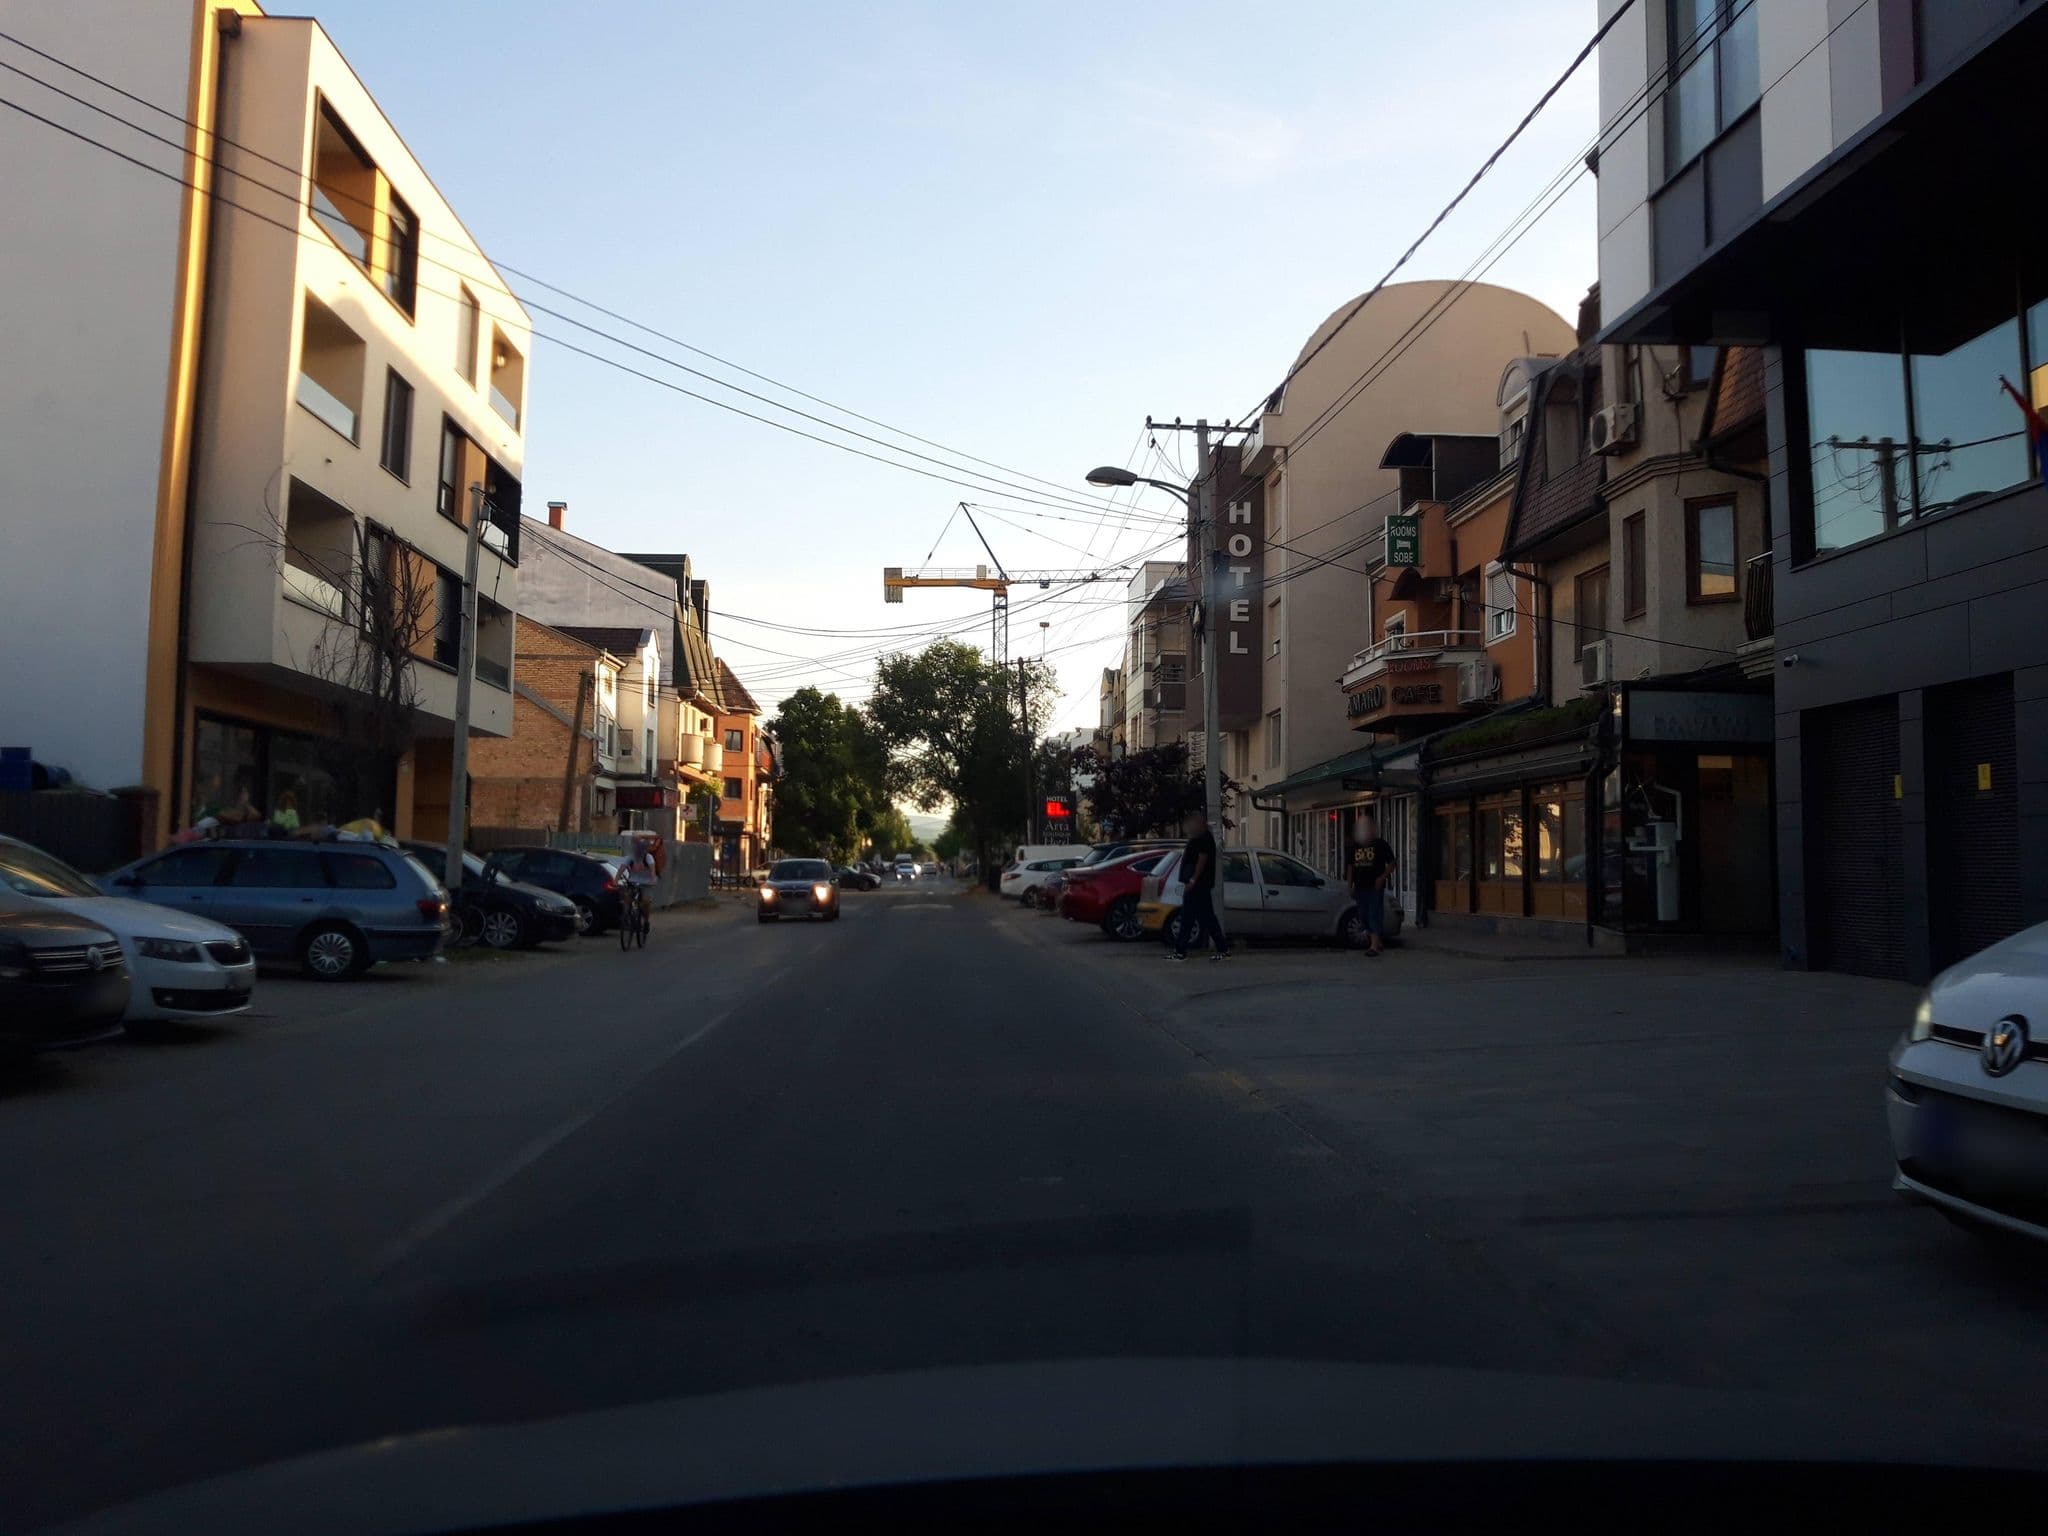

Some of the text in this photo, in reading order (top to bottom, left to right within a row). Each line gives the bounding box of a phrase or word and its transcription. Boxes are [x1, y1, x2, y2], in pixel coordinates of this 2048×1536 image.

[1391, 526, 1416, 537] ROOMS
[1394, 551, 1414, 563] SOBE
[1228, 501, 1252, 654] HOTEL
